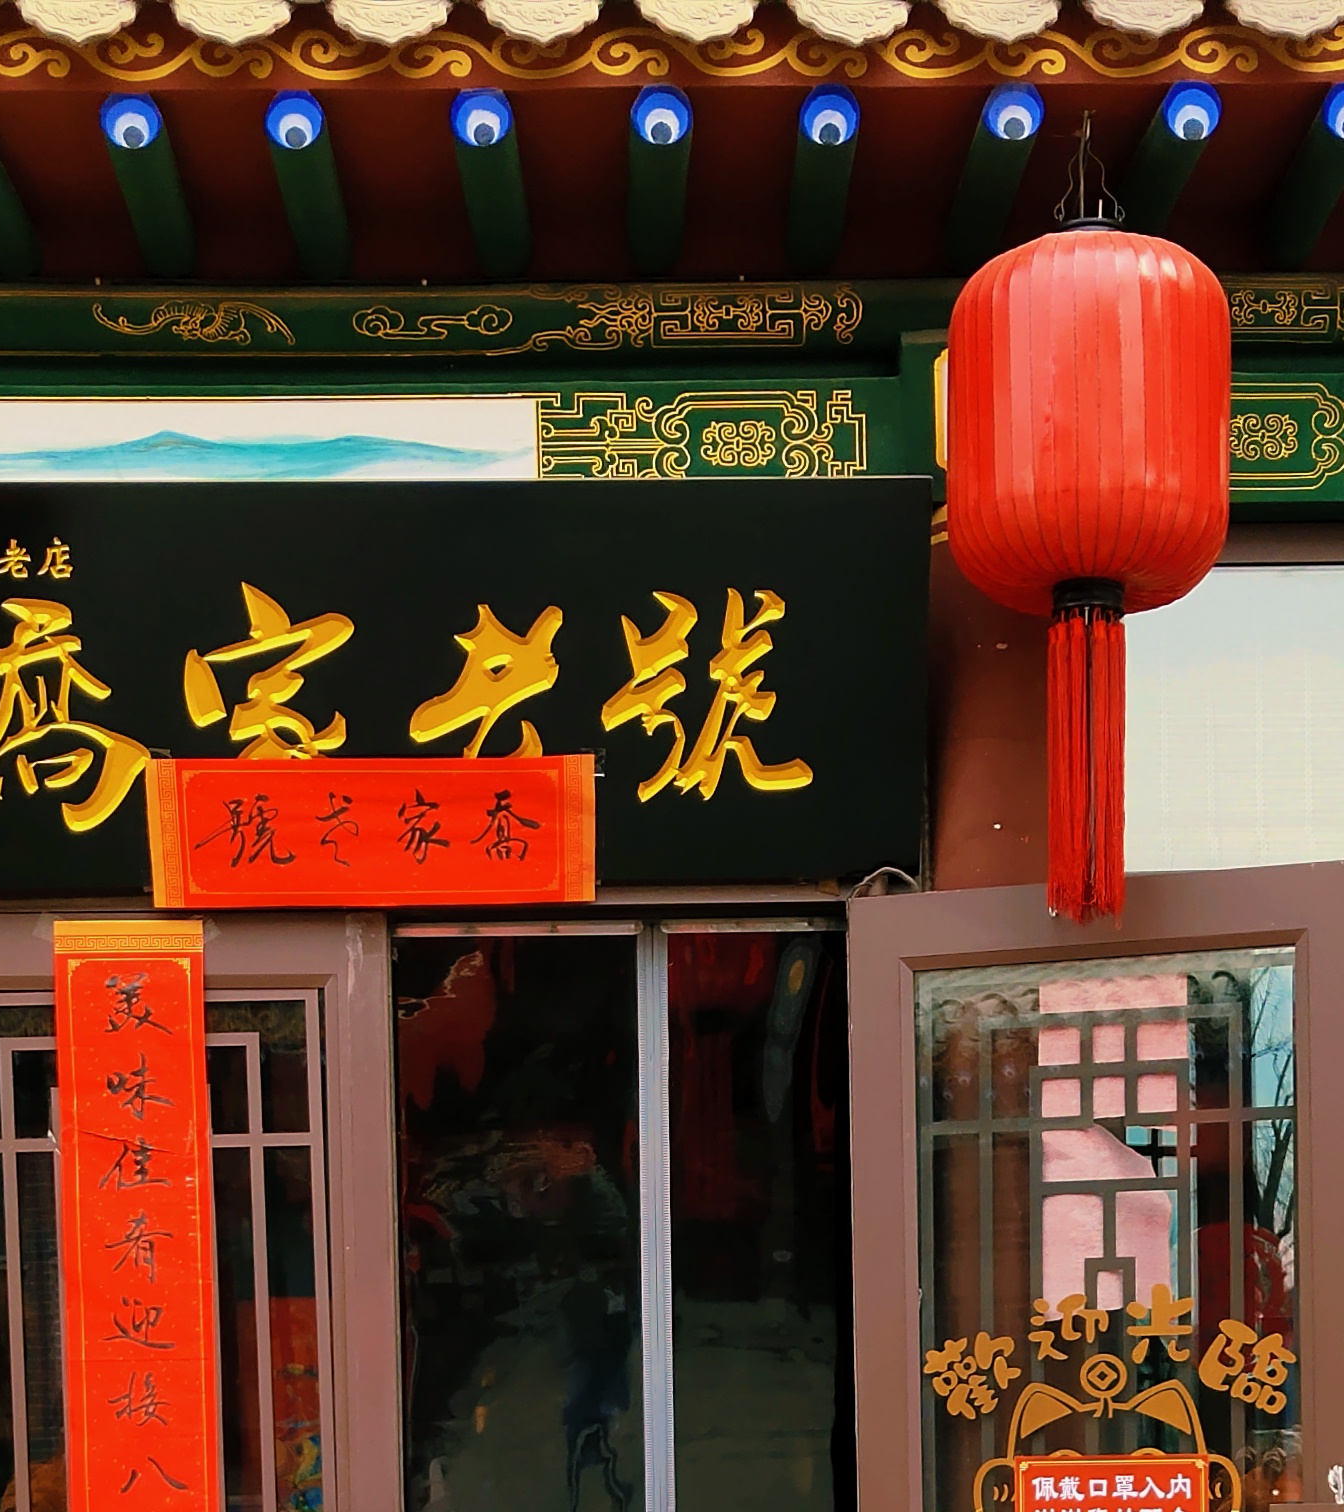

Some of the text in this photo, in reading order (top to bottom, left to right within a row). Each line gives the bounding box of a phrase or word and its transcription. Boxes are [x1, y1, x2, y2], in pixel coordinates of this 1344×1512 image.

[1032, 1473, 1193, 1502] 佩戴口罩入内
